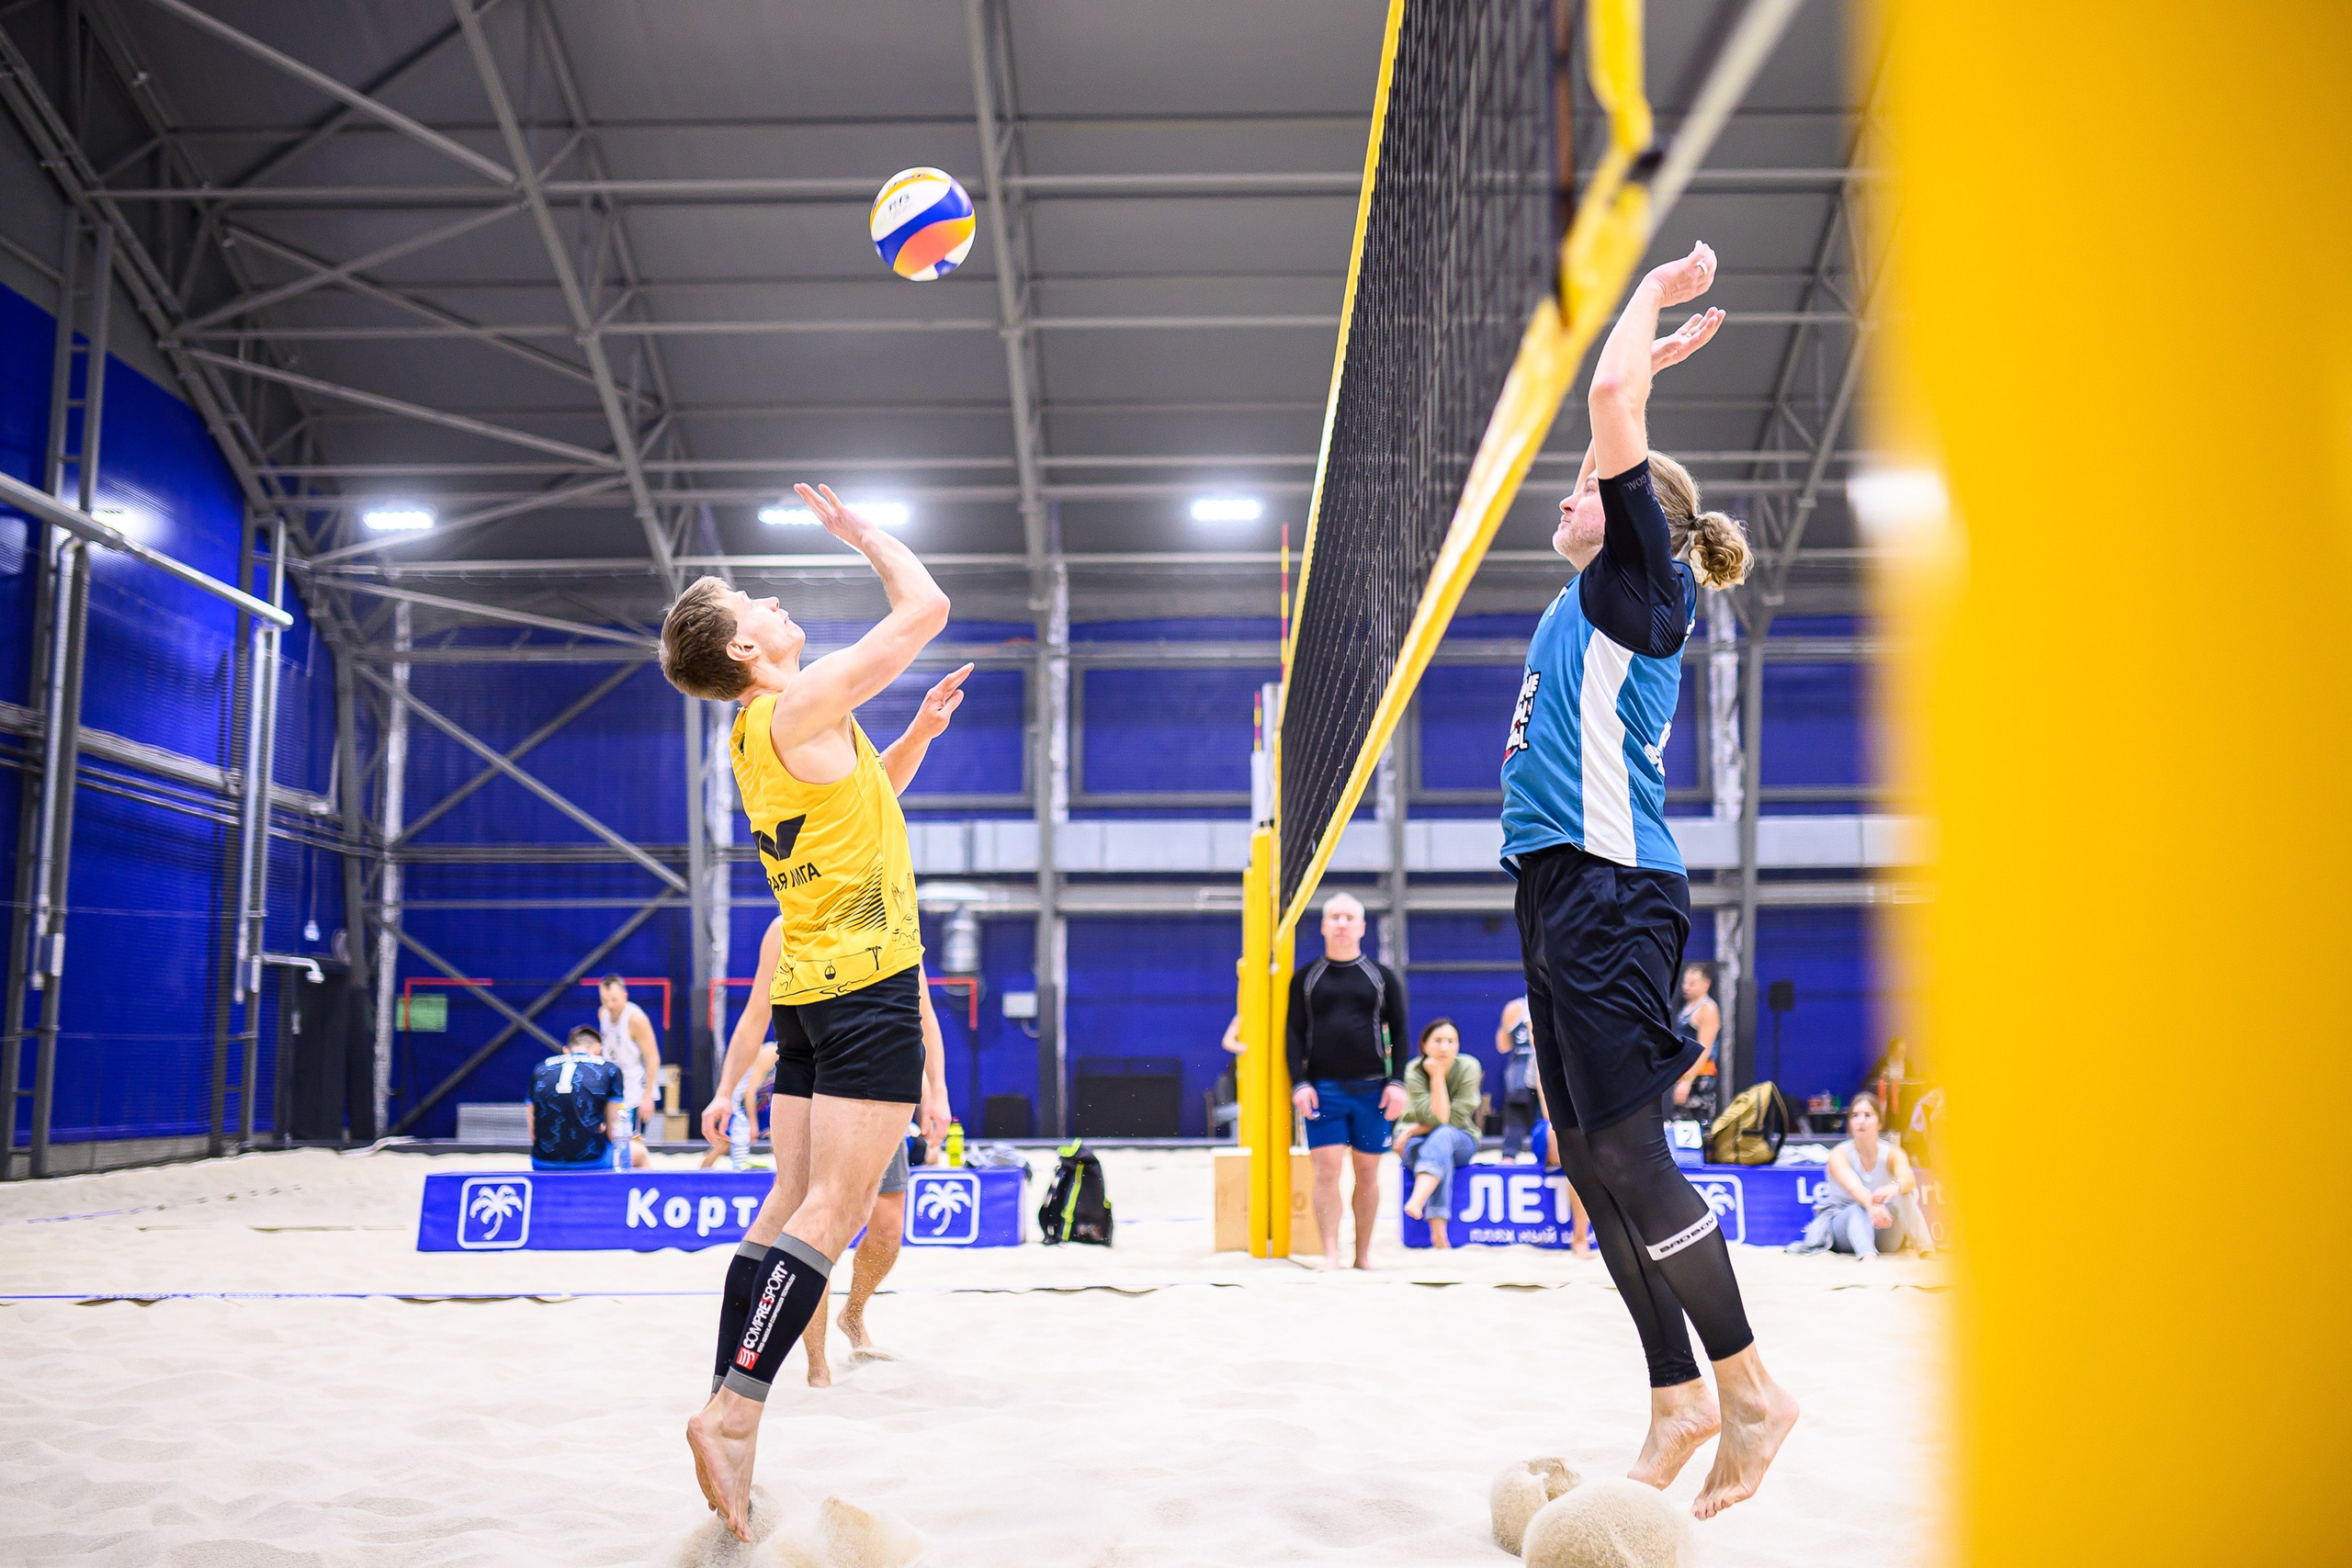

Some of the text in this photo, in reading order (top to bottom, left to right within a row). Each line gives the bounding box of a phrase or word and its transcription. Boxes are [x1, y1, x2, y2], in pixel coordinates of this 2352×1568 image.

[789, 862, 821, 887] ЛИГА
[555, 1061, 578, 1094] 1
[626, 1187, 759, 1237] Корт
[1459, 1174, 1573, 1224] ЛЕТ
